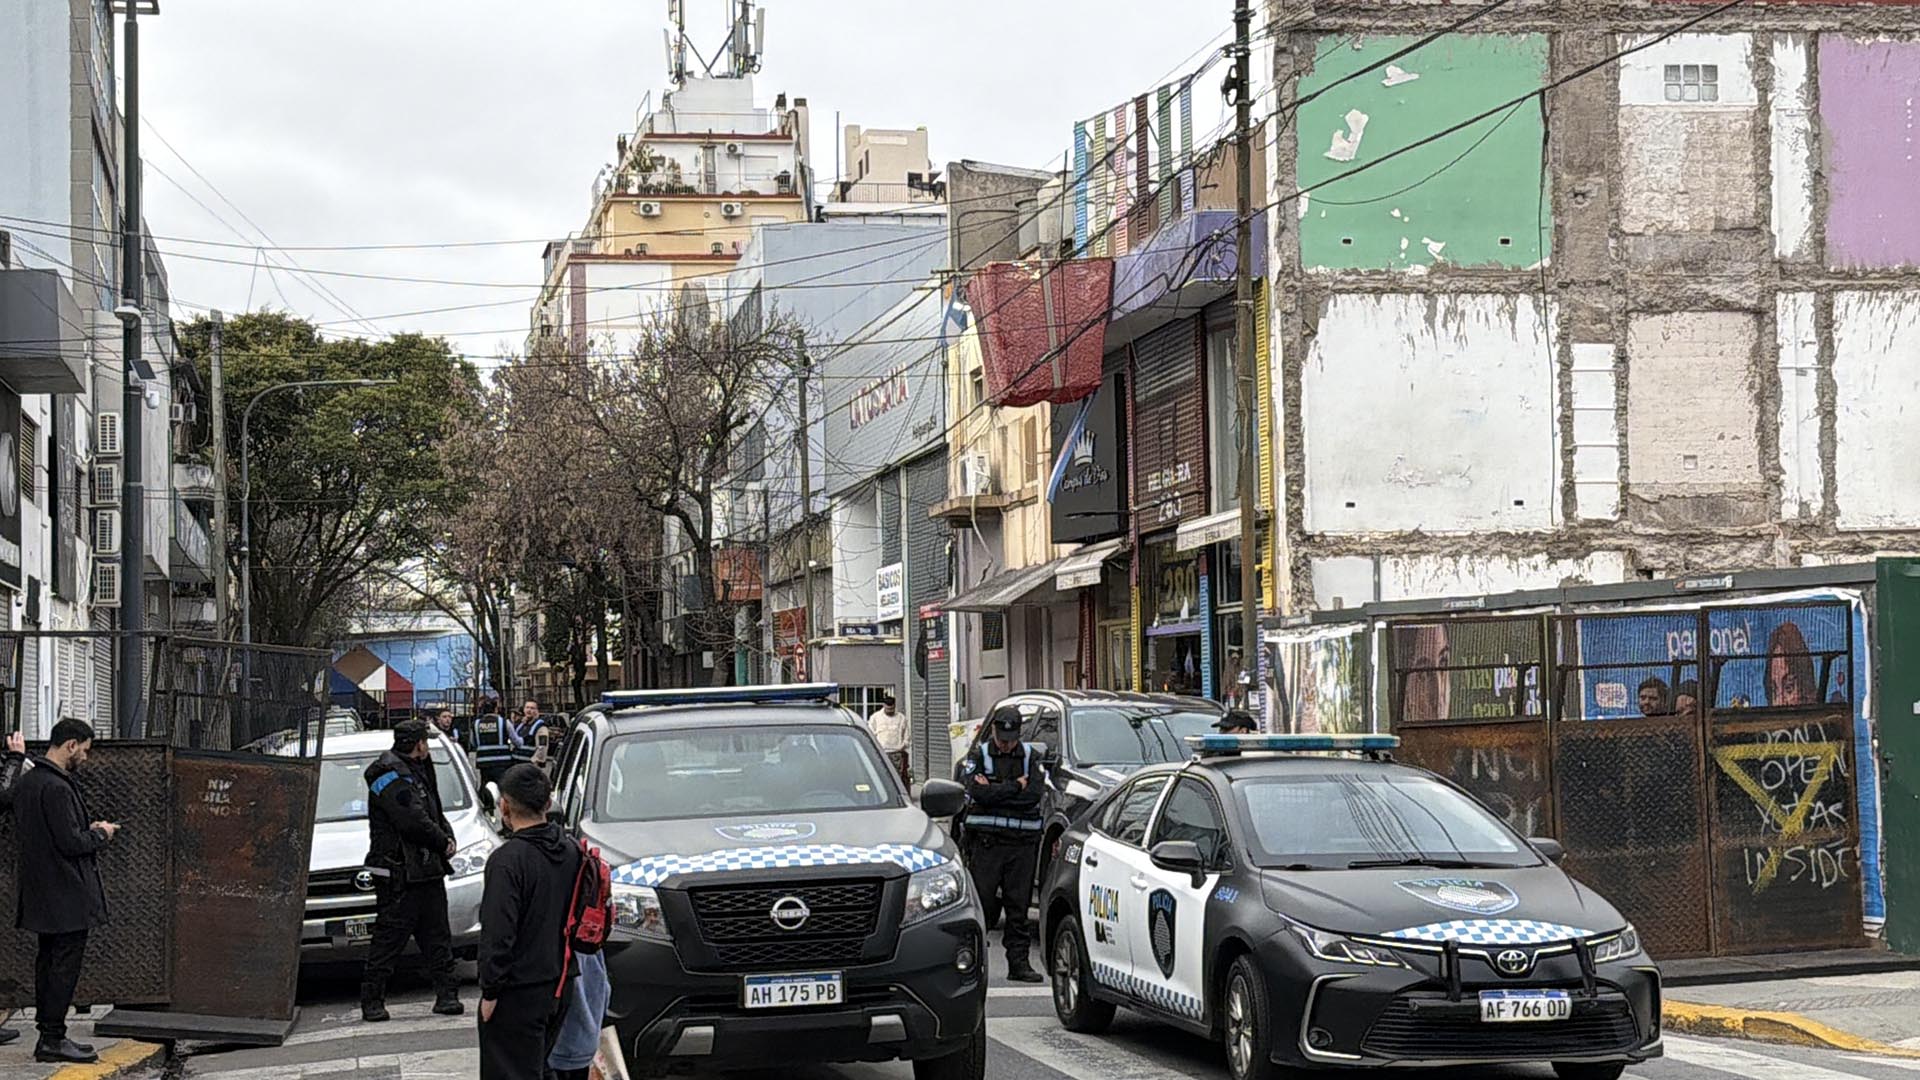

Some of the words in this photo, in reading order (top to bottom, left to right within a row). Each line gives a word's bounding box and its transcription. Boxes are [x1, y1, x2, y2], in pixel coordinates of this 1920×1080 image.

[1088, 884, 1119, 923] POLICIA
[751, 987, 772, 1004] AH
[778, 984, 810, 1002] 175
[815, 983, 836, 1000] PB
[1487, 1001, 1506, 1018] AF
[1511, 1000, 1541, 1017] 766
